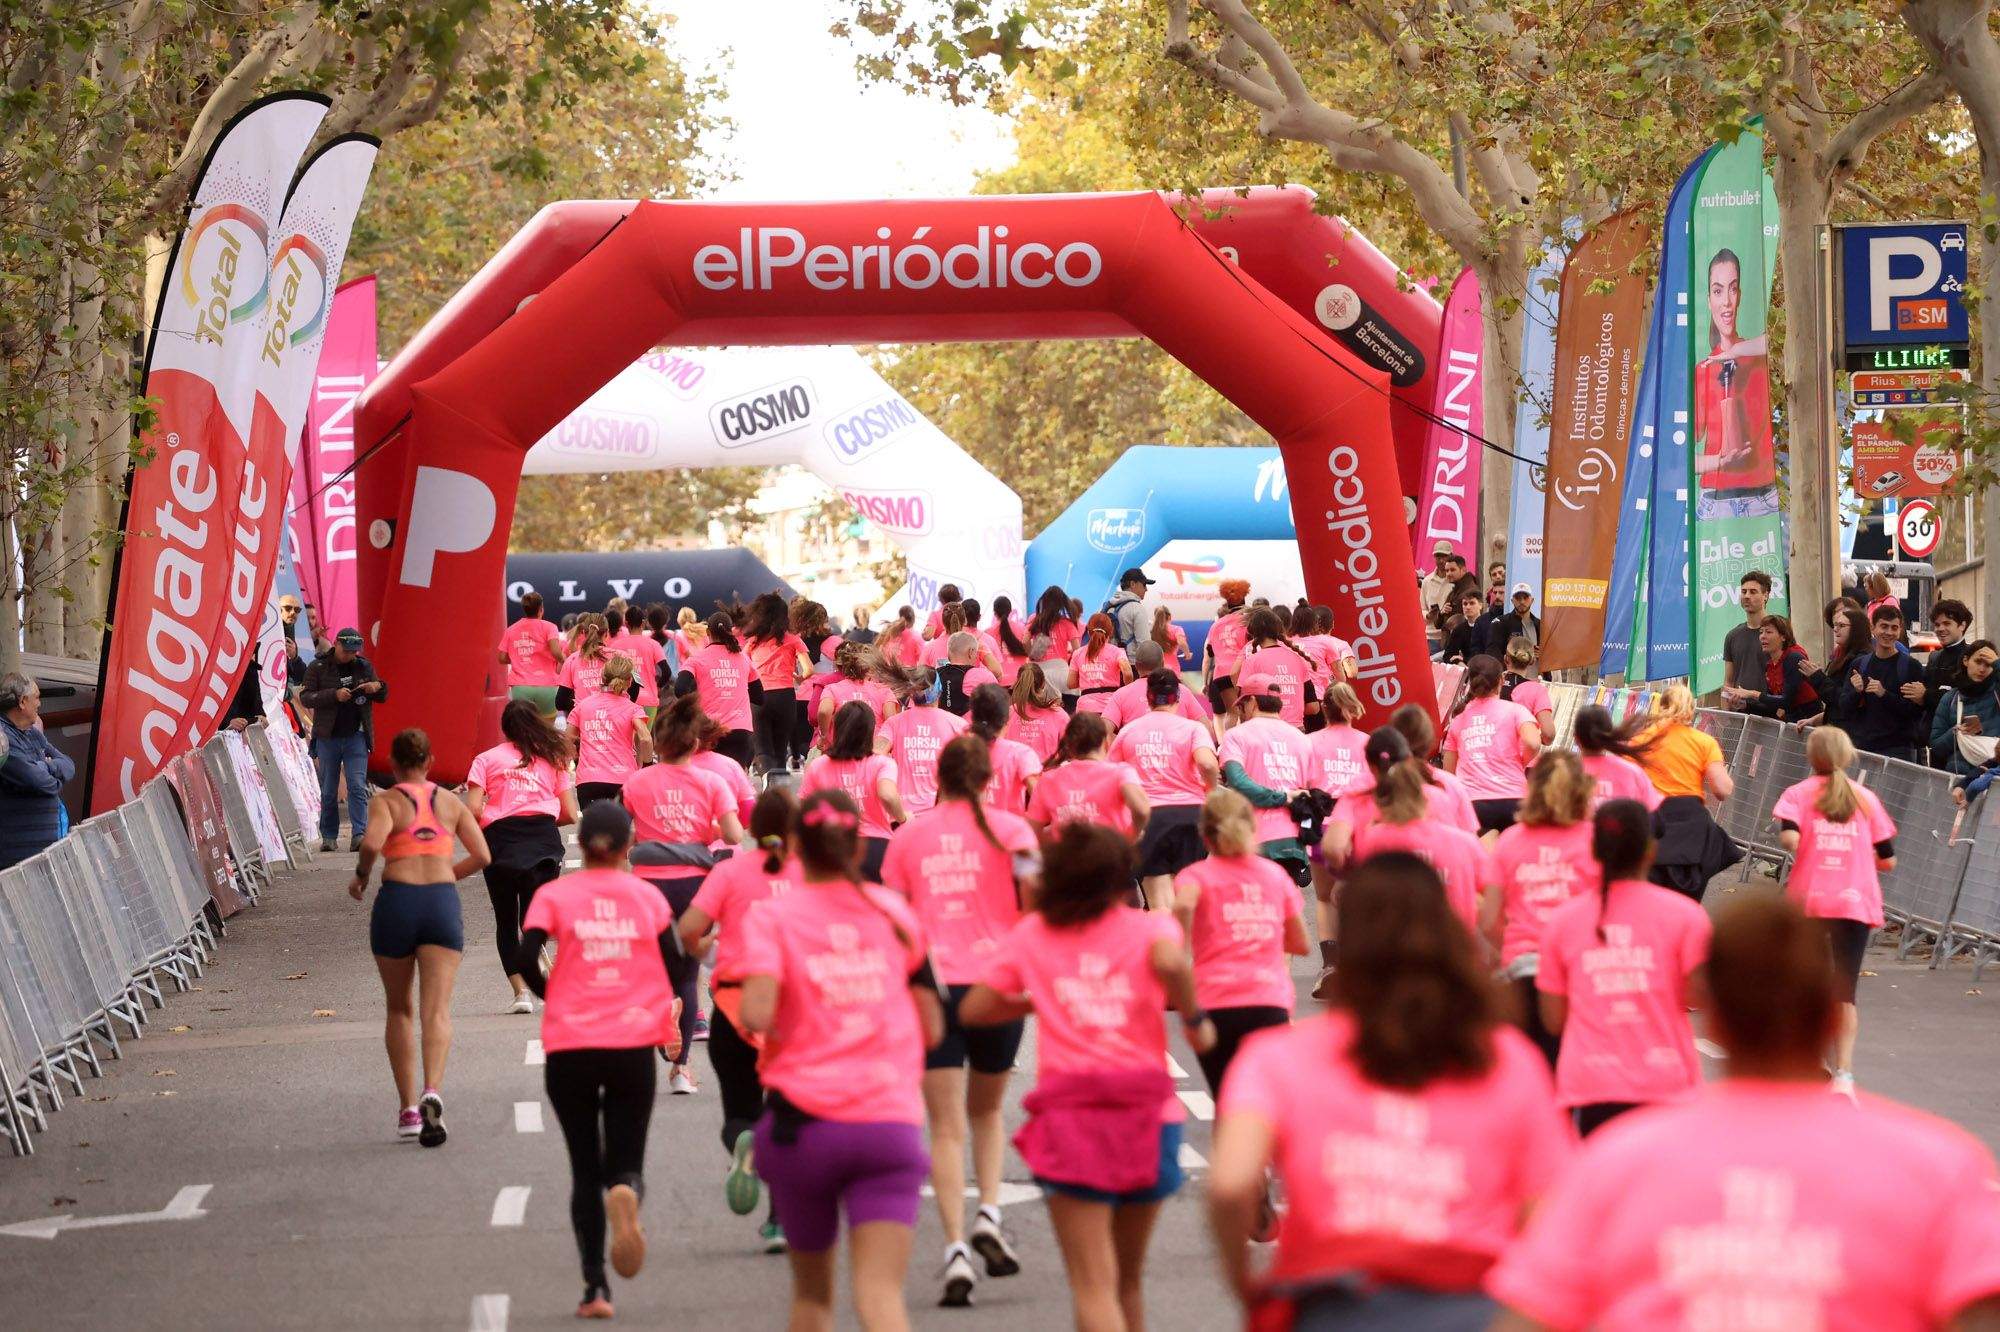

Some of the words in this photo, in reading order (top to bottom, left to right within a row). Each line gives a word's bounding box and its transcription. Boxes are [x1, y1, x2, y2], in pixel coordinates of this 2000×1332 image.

[1701, 190, 1760, 207] nutribullet
[693, 225, 1102, 290] elPeriódico
[195, 226, 241, 347] Total
[1870, 236, 1942, 331] P
[262, 254, 302, 368] Total
[1363, 320, 1407, 362] Ajuntament
[1403, 354, 1415, 366] de
[1355, 327, 1406, 377] Barcelona
[1590, 312, 1614, 441] Odontológicos
[1620, 348, 1631, 395] dentales
[1870, 376, 1896, 386] Rius
[1570, 355, 1591, 441] Institutos
[720, 384, 811, 441] COSMO
[1616, 398, 1627, 441] Clínicas
[558, 414, 650, 454] COSMO
[1426, 349, 1479, 543] DRUNI
[1917, 458, 1952, 471] 30%
[400, 465, 497, 589] P
[1907, 521, 1931, 538] 30
[1752, 531, 1776, 557] al
[1325, 446, 1401, 706] elPeriódico
[506, 576, 692, 603] OLVO
[719, 660, 731, 668] TU
[1277, 665, 1288, 674] TU
[710, 668, 741, 679] DORSAL
[1274, 674, 1298, 685] ORSAL
[714, 678, 738, 688] SUMA
[1471, 714, 1486, 726] TU
[917, 725, 931, 736] TU
[1148, 731, 1163, 743] TU
[903, 736, 942, 750] DORSAL
[1135, 742, 1175, 756] DORSAL
[1272, 742, 1287, 755] TU
[908, 749, 937, 762] SUMA
[1141, 755, 1170, 769] SUMA
[1263, 752, 1298, 770] DORSAL
[1337, 748, 1351, 760] TU
[1324, 760, 1363, 775] DORSAL
[842, 774, 856, 787] TU
[667, 789, 683, 803] TU
[1069, 790, 1085, 803] TU
[654, 802, 698, 819] DORSAL
[593, 899, 618, 919] TU
[574, 919, 639, 940] DORSAL
[582, 938, 633, 962] SUMA
